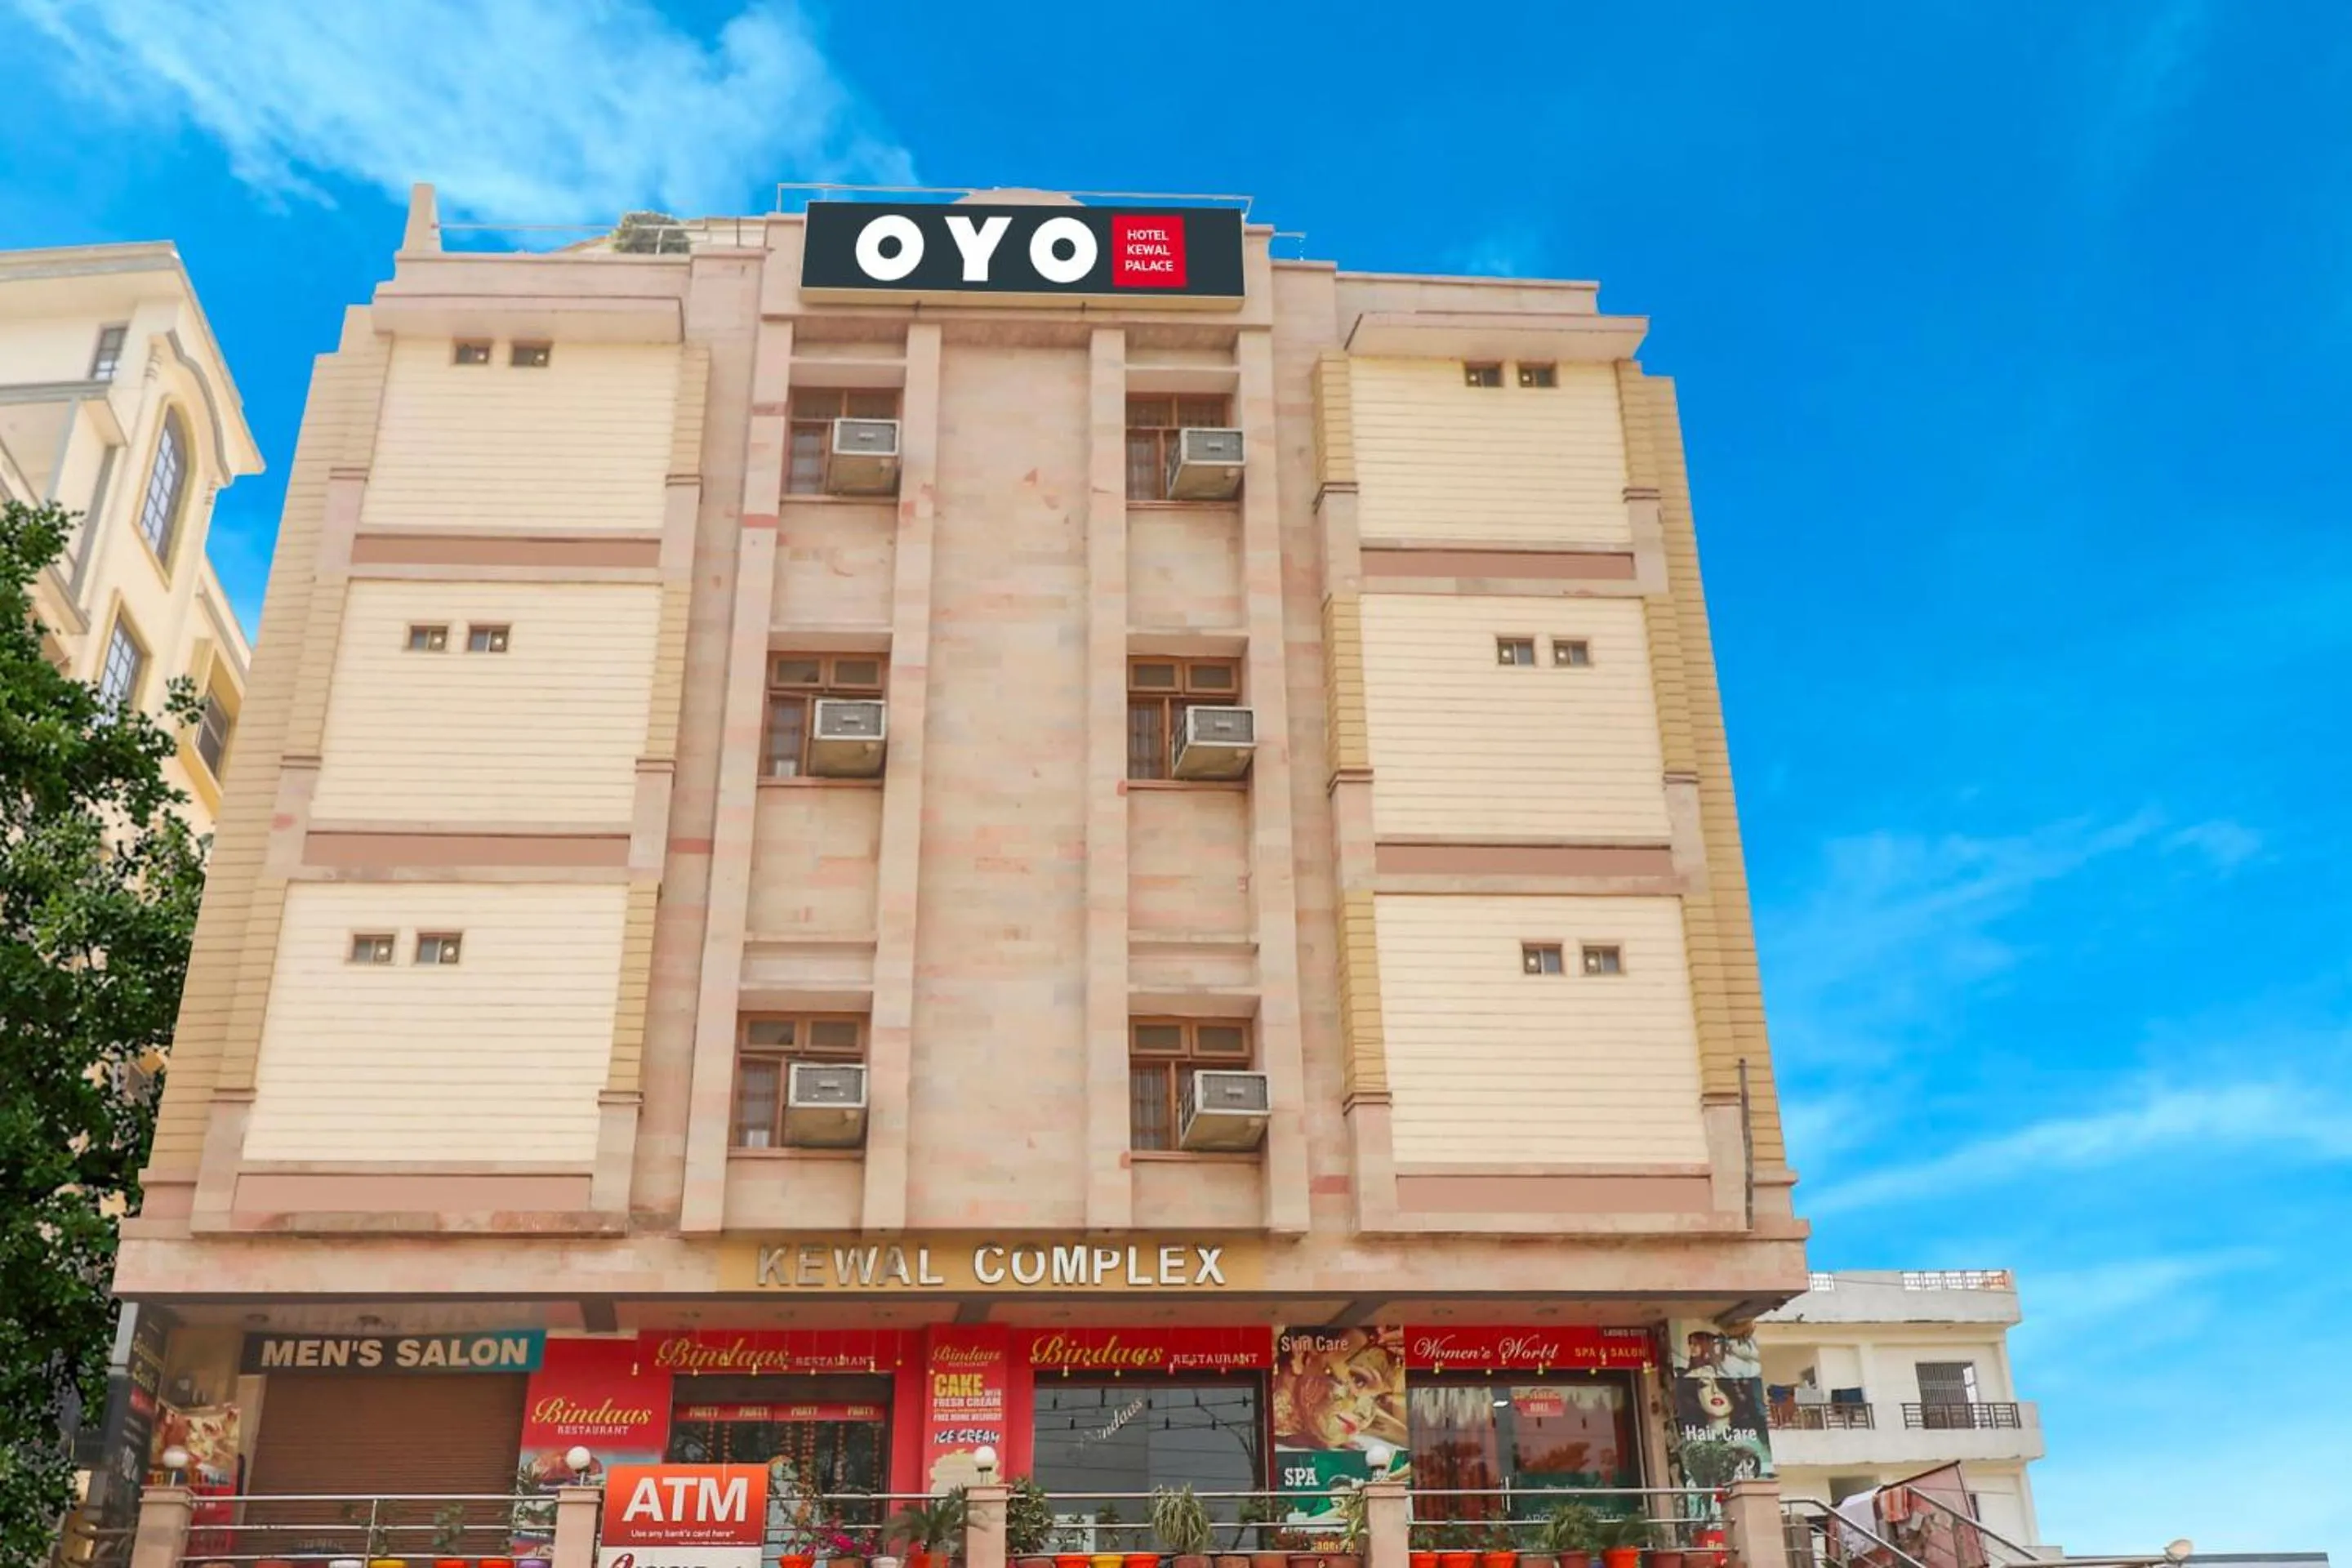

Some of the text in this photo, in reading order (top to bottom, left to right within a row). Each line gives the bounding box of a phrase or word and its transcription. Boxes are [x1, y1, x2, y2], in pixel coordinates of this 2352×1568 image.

[1127, 229, 1169, 241] HOTEL
[855, 214, 1098, 283] OYO
[1127, 244, 1171, 256] KEWAL
[1125, 260, 1174, 272] PALACE
[756, 1244, 1227, 1287] KEWAL COMPLEX
[1029, 1335, 1164, 1365] Bindaas
[1316, 1335, 1349, 1352] Care
[1414, 1334, 1559, 1360] Women's World
[1575, 1347, 1597, 1357] SPA
[1610, 1347, 1646, 1358] SALON
[261, 1338, 529, 1368] MEN'S SALON
[654, 1338, 790, 1368] Bindaas
[934, 1374, 984, 1396] CAKE
[532, 1396, 653, 1424] Bindaas
[966, 1397, 1001, 1407] CREAM
[557, 1425, 629, 1435] RESTAURANT
[933, 1429, 955, 1444] ICE
[1685, 1424, 1757, 1441] Hair Care
[1284, 1467, 1320, 1487] SPA
[621, 1477, 748, 1522] ATM
[631, 1529, 647, 1537] Use
[648, 1530, 663, 1539] any
[665, 1529, 691, 1537] bank's
[693, 1529, 710, 1537] card
